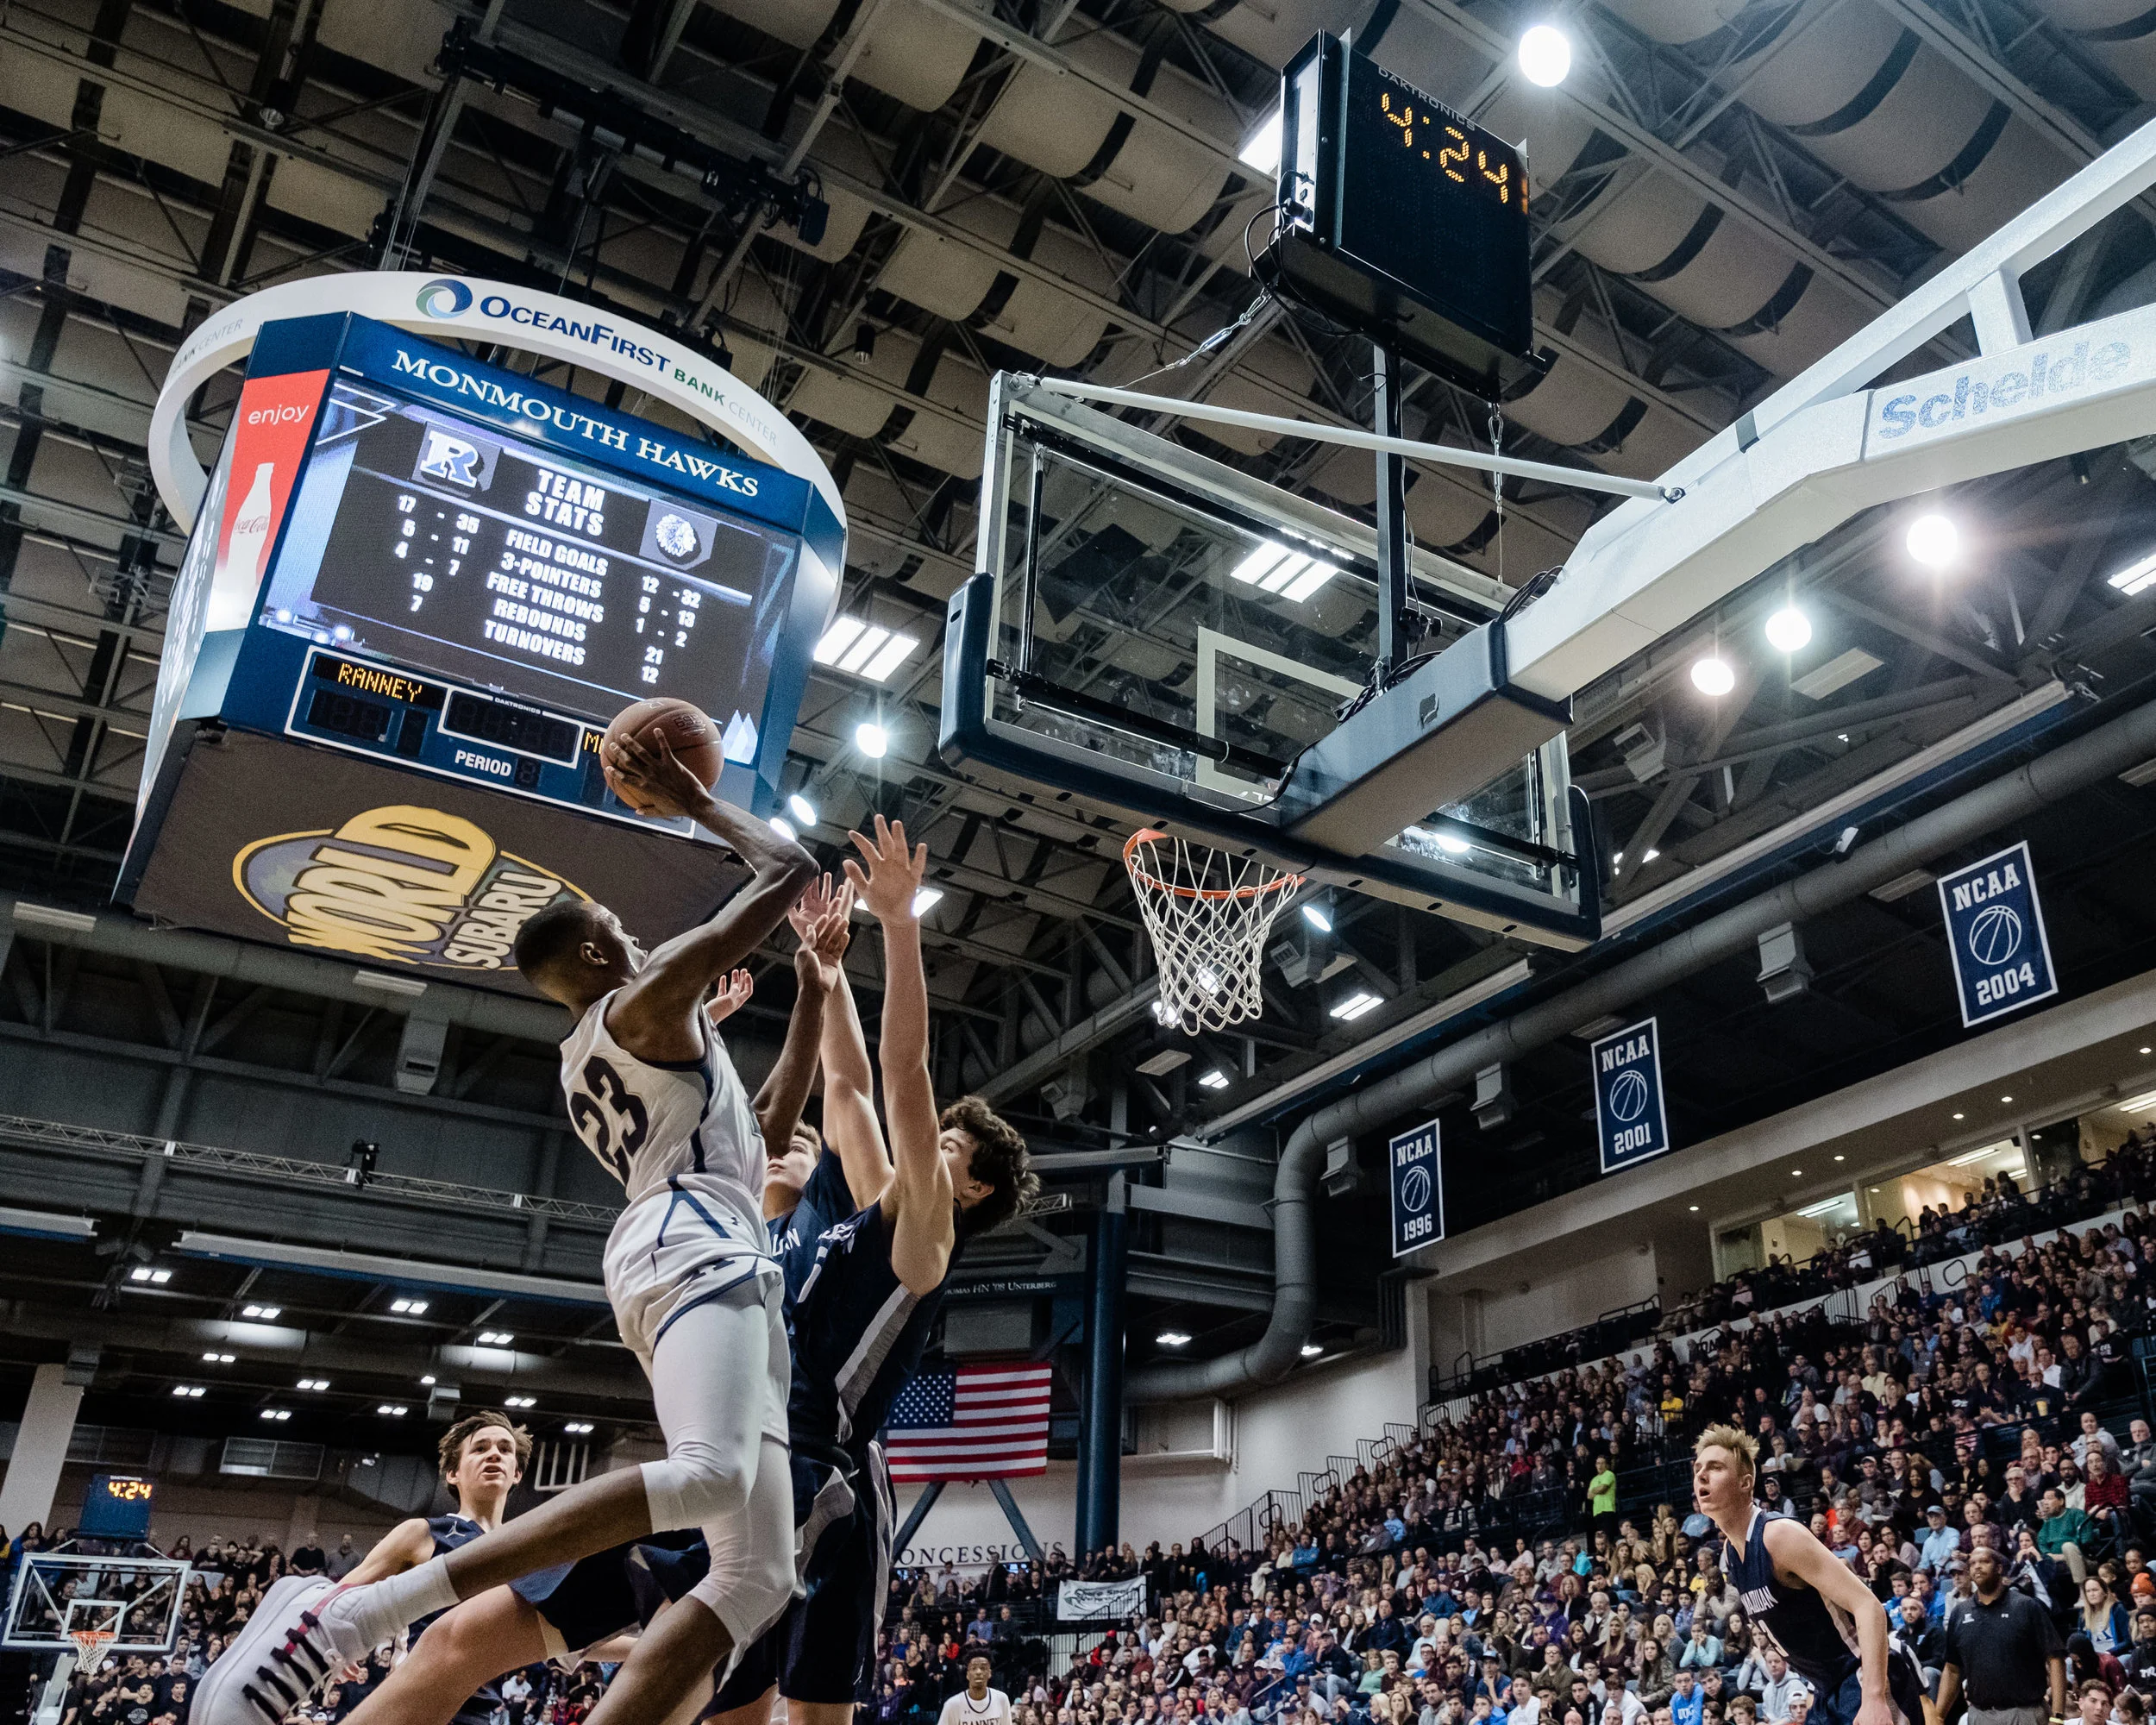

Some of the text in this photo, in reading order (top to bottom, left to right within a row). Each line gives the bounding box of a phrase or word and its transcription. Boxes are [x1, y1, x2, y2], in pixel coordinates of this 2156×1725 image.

[1378, 66, 1476, 131] DAKTRONICS
[1382, 92, 1508, 204] 4:24
[674, 367, 725, 407] BANK
[728, 400, 777, 448] CENTER
[1878, 341, 2132, 440] Schelde
[248, 403, 310, 427] enjoy
[392, 348, 759, 498] MONMOUTH HAWKS
[538, 468, 605, 512] TEAM
[398, 494, 417, 513] 17
[456, 513, 480, 534] 35
[524, 491, 604, 536] STATS
[395, 541, 409, 559] 4
[448, 559, 461, 576] 7
[453, 536, 470, 555] 11
[505, 529, 609, 576] FIELD GOALS
[500, 551, 602, 599] 3-POINTERS
[642, 575, 660, 593] 12
[681, 589, 701, 609] 32
[411, 594, 423, 612] 7
[486, 571, 605, 624] FREE THROWS
[493, 598, 586, 642] REBOUNDS
[636, 618, 645, 633] 1
[675, 630, 687, 648] 2
[485, 618, 586, 666] TURNOVERS
[644, 646, 664, 665] 21
[337, 662, 423, 702] RANNEY
[642, 666, 660, 684] 12
[494, 697, 542, 715] DAKTRONICS
[454, 750, 511, 777] PERIOD
[287, 805, 496, 965] WORLD
[1952, 862, 2021, 912] NCAA
[443, 871, 561, 969] SUBARU
[1975, 962, 2035, 1006] 2004
[1601, 1034, 1651, 1072] NCAA
[570, 1055, 649, 1187] 23
[1614, 1122, 1651, 1155] 2001
[1396, 1134, 1433, 1167] NCAA
[1403, 1213, 1432, 1241] 1996
[108, 1481, 153, 1500] 4:24
[899, 1541, 1065, 1565] ONCESSIOS
